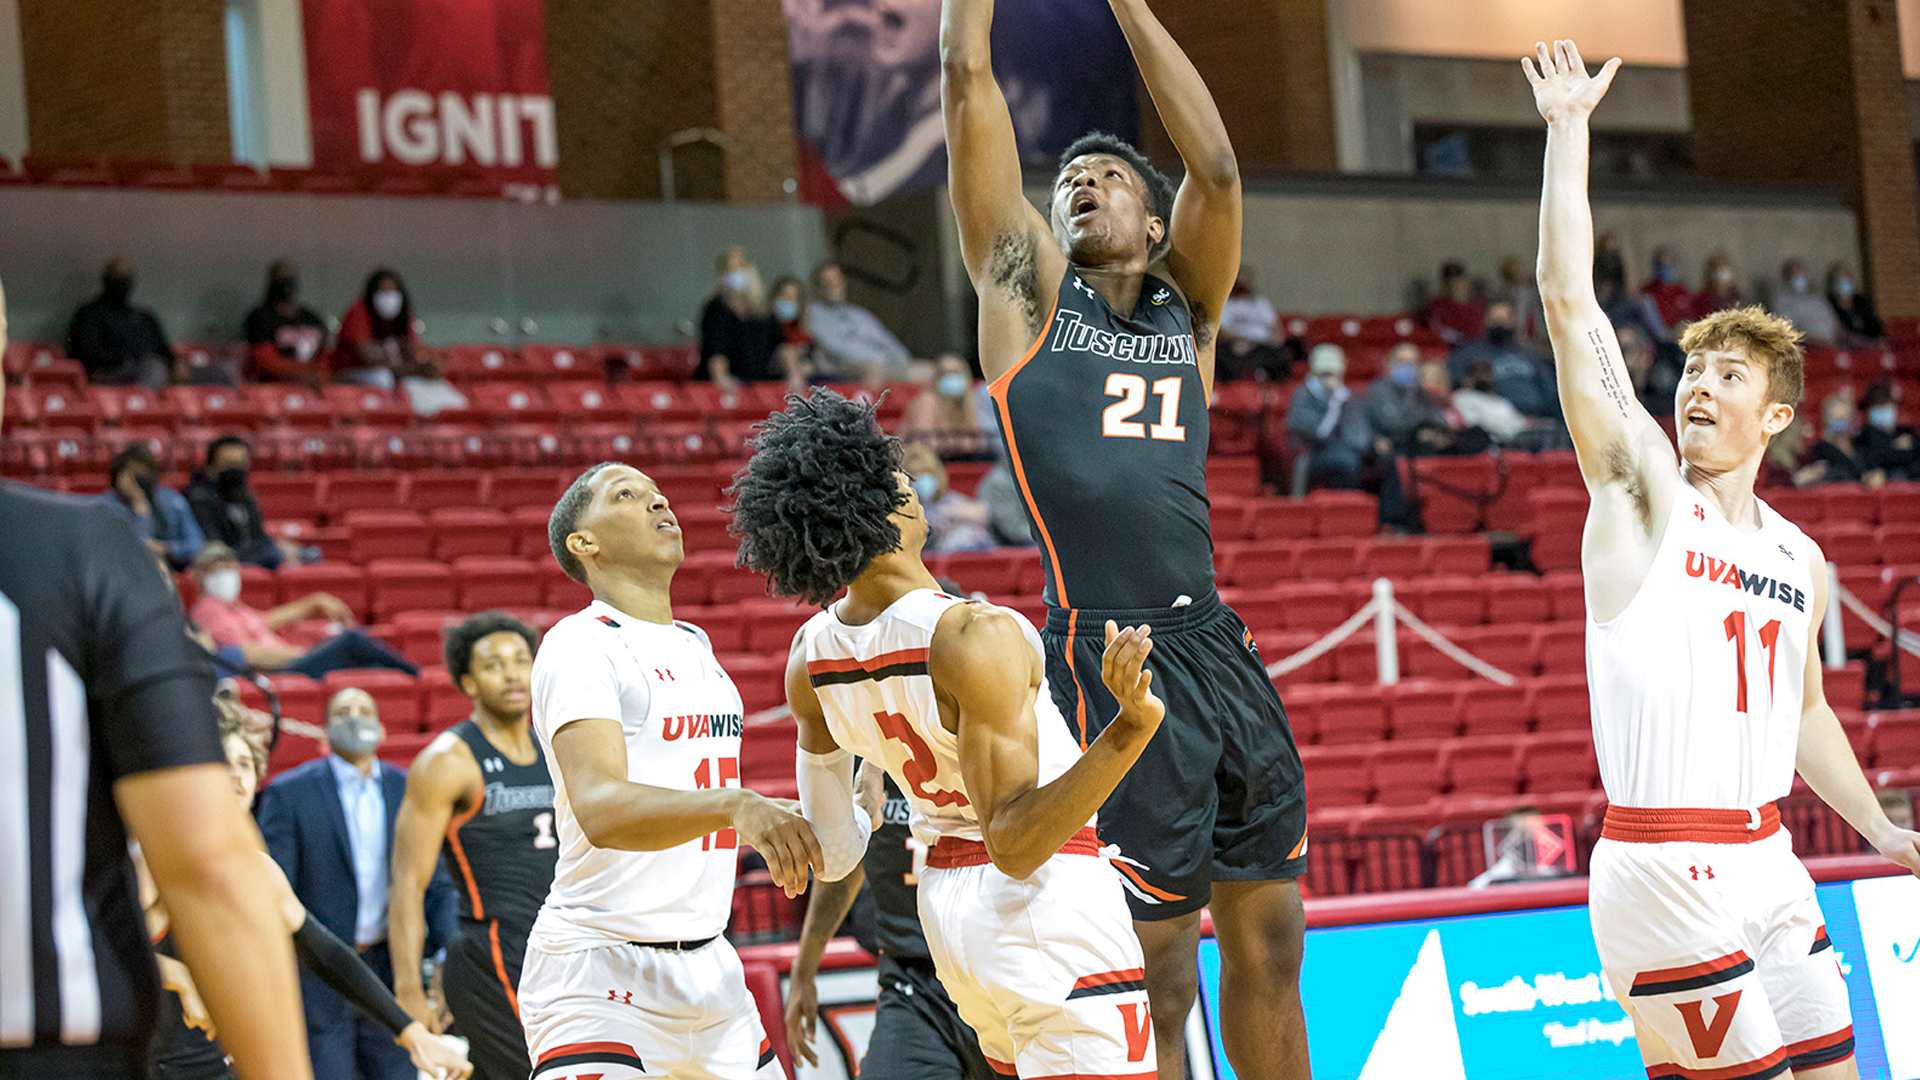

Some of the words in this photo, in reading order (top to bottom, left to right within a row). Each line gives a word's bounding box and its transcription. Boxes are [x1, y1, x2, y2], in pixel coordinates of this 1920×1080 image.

[1102, 372, 1186, 442] 21
[1685, 550, 1805, 613] UVAWISE
[1723, 609, 1781, 713] 11
[873, 710, 971, 808] 2
[533, 812, 556, 850] 1
[1673, 990, 1743, 1059] V
